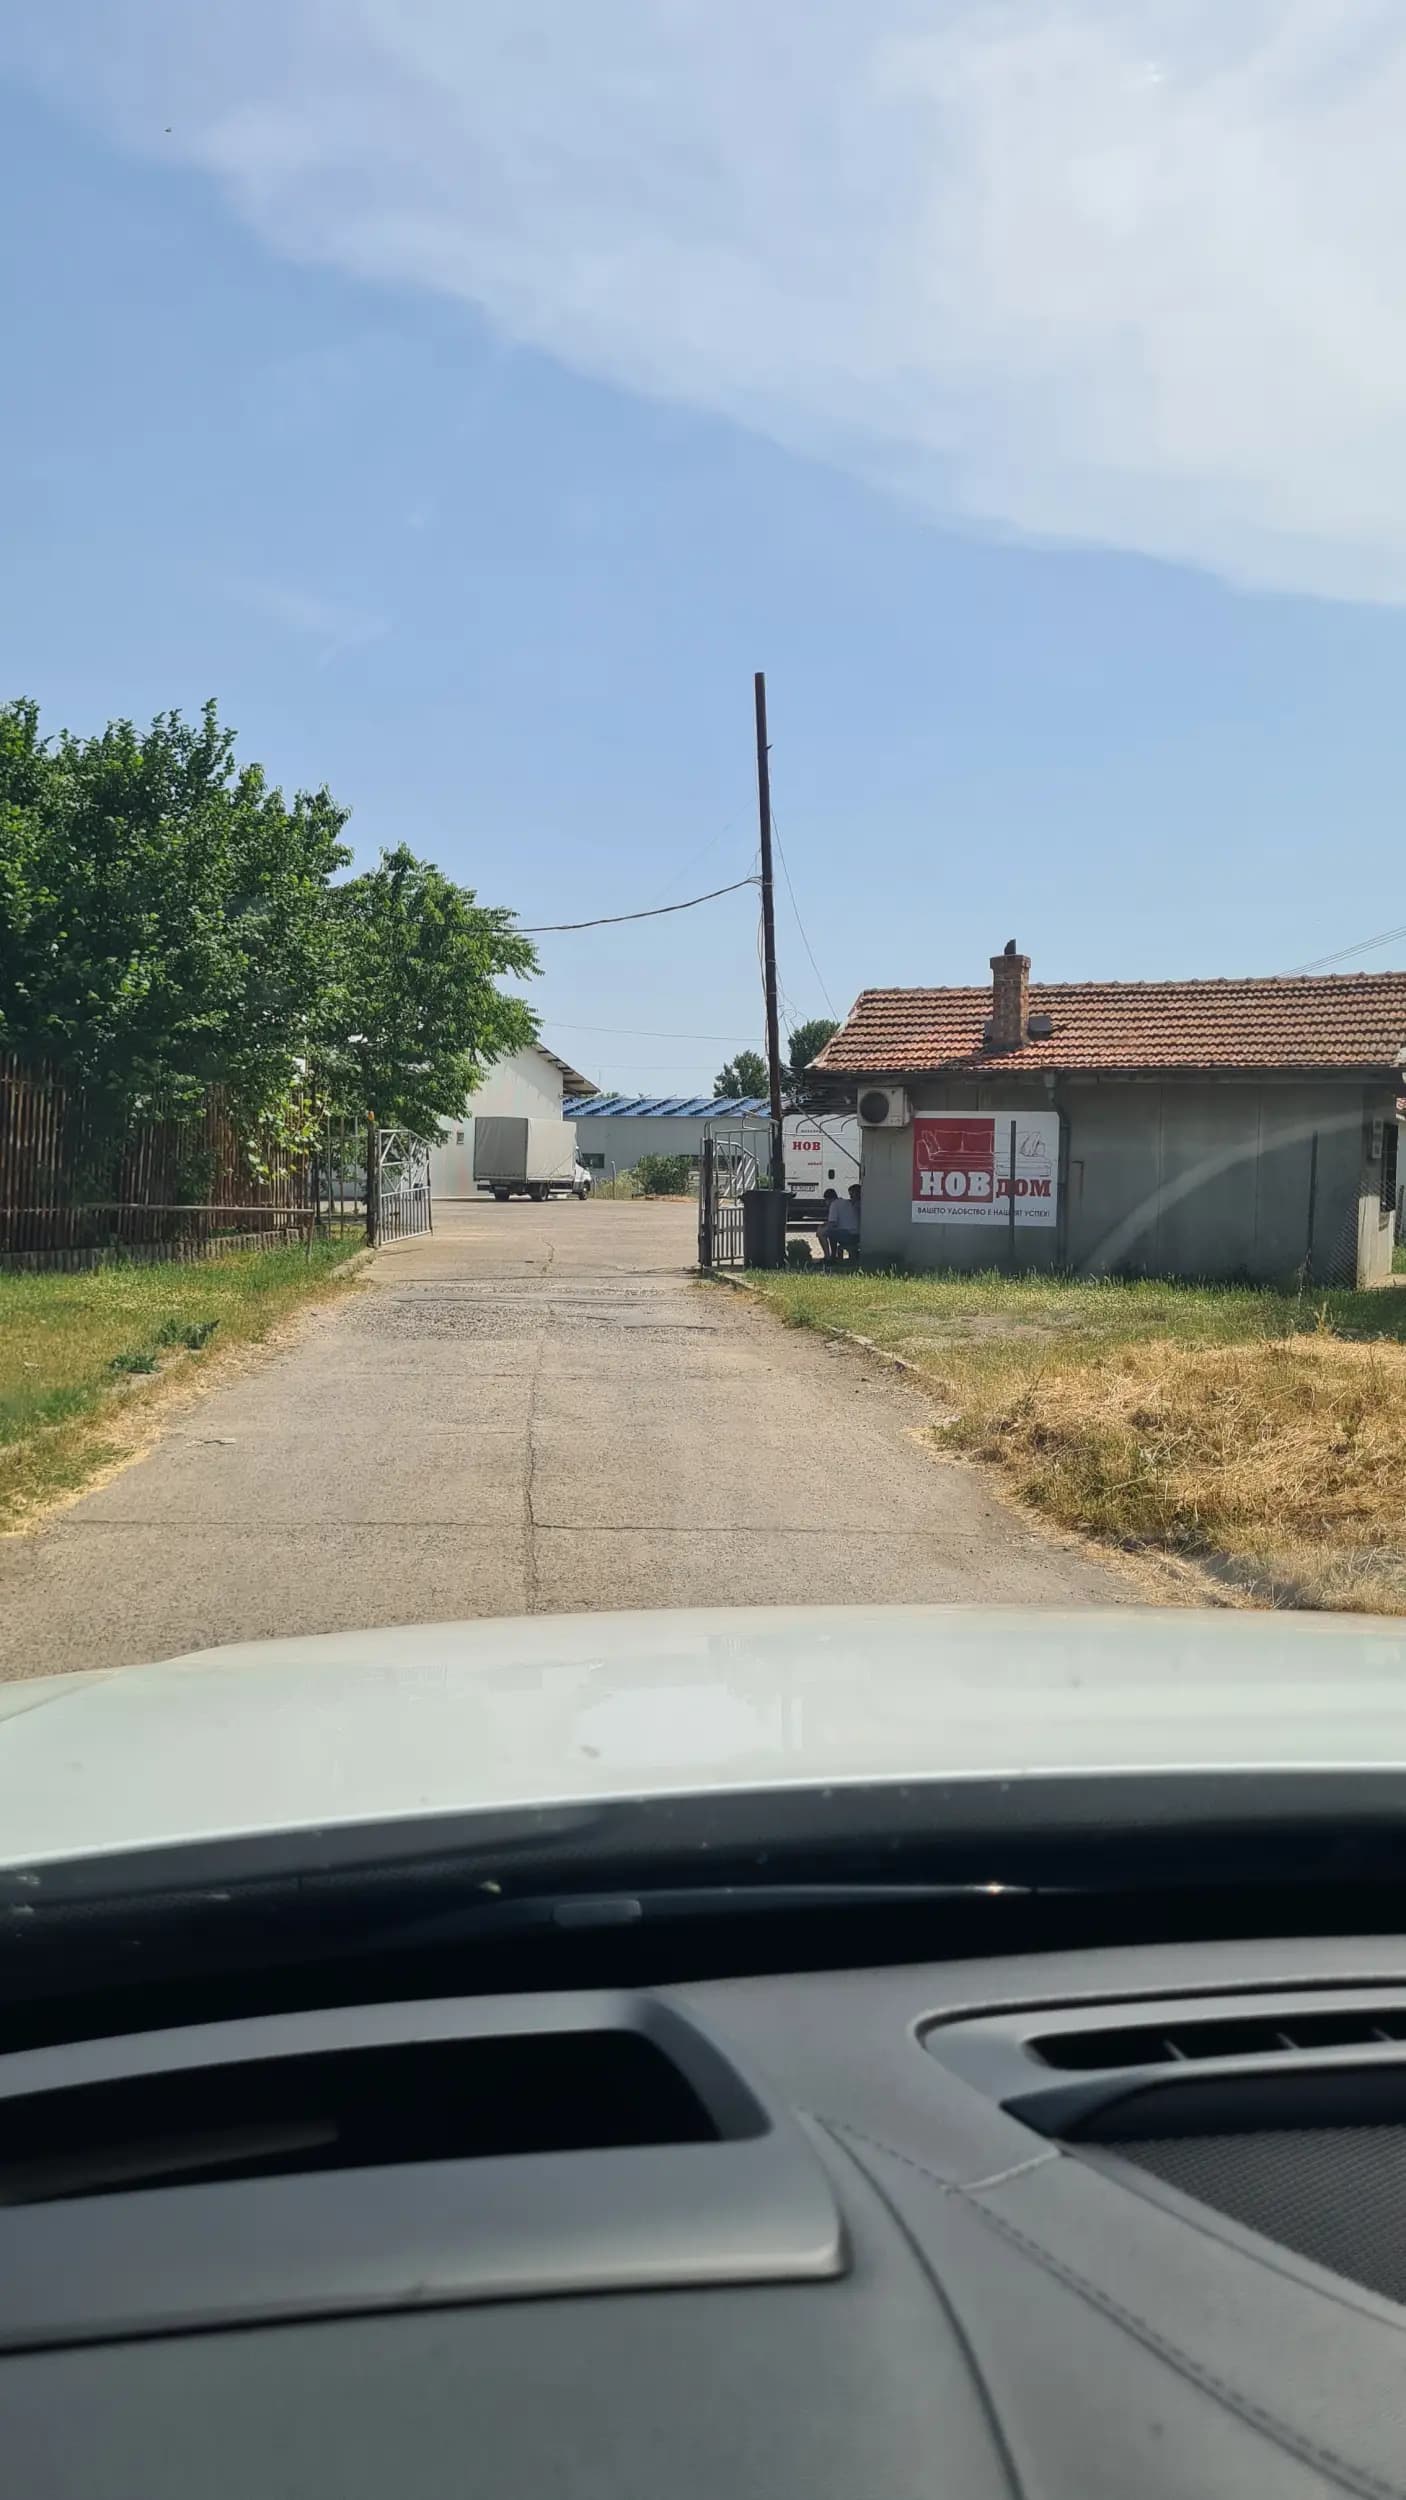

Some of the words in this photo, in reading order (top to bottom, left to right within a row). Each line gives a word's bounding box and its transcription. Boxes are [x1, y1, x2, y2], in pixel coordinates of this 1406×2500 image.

[792, 1141, 821, 1151] НОВ
[919, 1171, 991, 1197] НОВ
[996, 1179, 1052, 1198] ДОМ
[917, 1207, 946, 1215] ВАШЕТО
[948, 1207, 985, 1216] УДОБСТВО
[993, 1208, 1022, 1217] НАШЯТ
